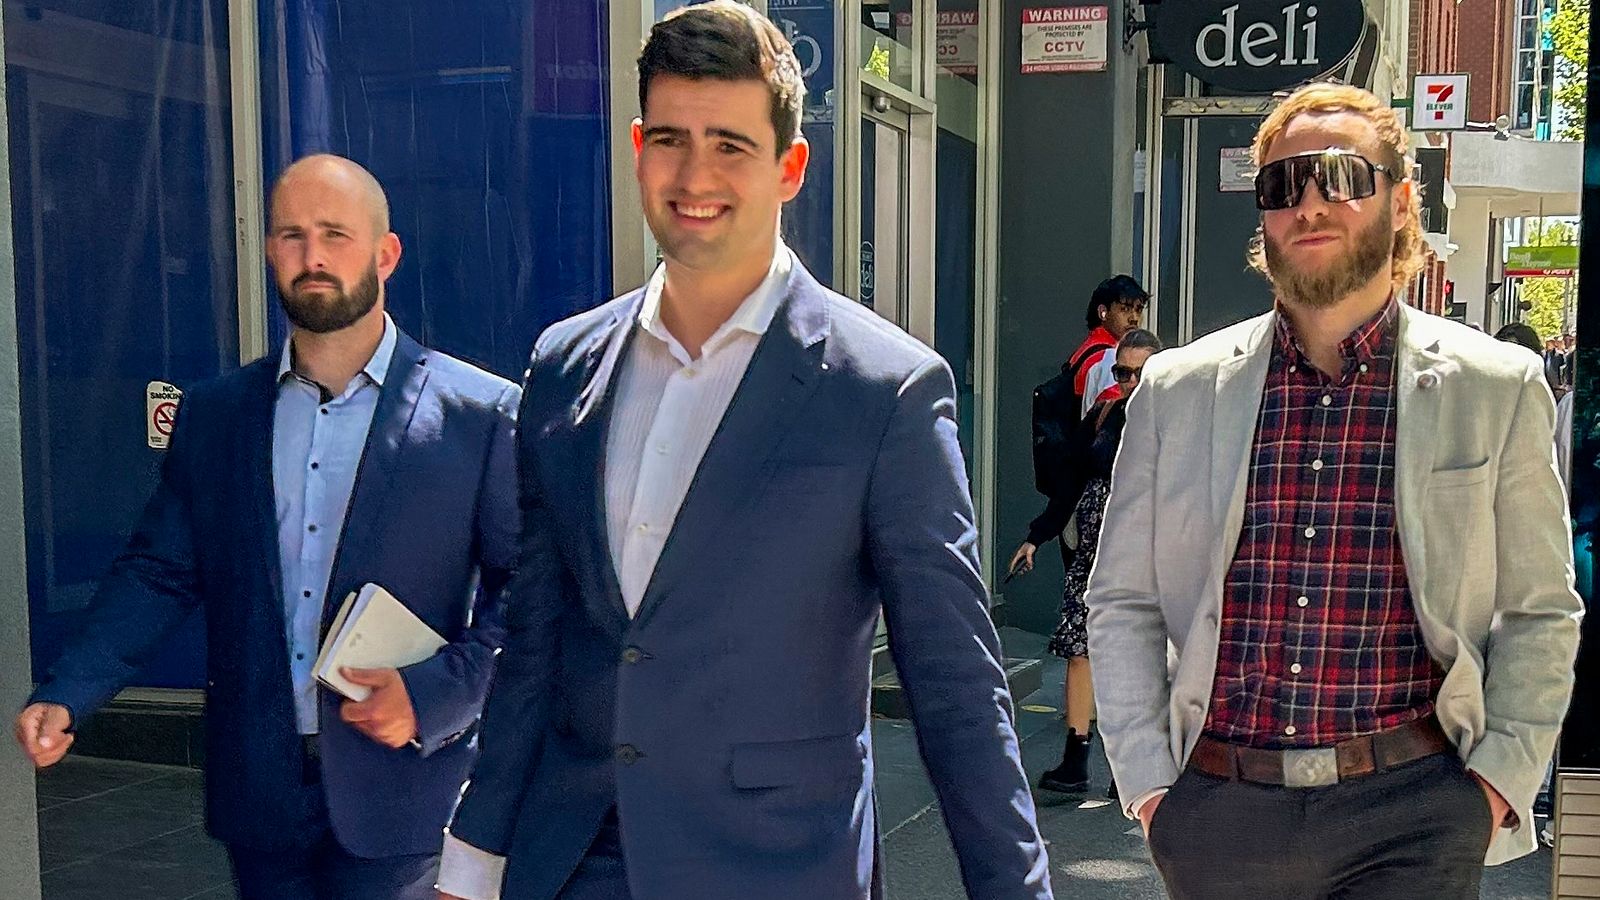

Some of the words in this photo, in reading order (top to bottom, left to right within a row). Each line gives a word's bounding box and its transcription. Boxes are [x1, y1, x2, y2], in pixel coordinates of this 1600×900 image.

[1028, 7, 1102, 21] WARNING
[1195, 2, 1319, 68] deli
[1044, 41, 1085, 53] CCTV
[150, 392, 181, 400] SMOKIN
